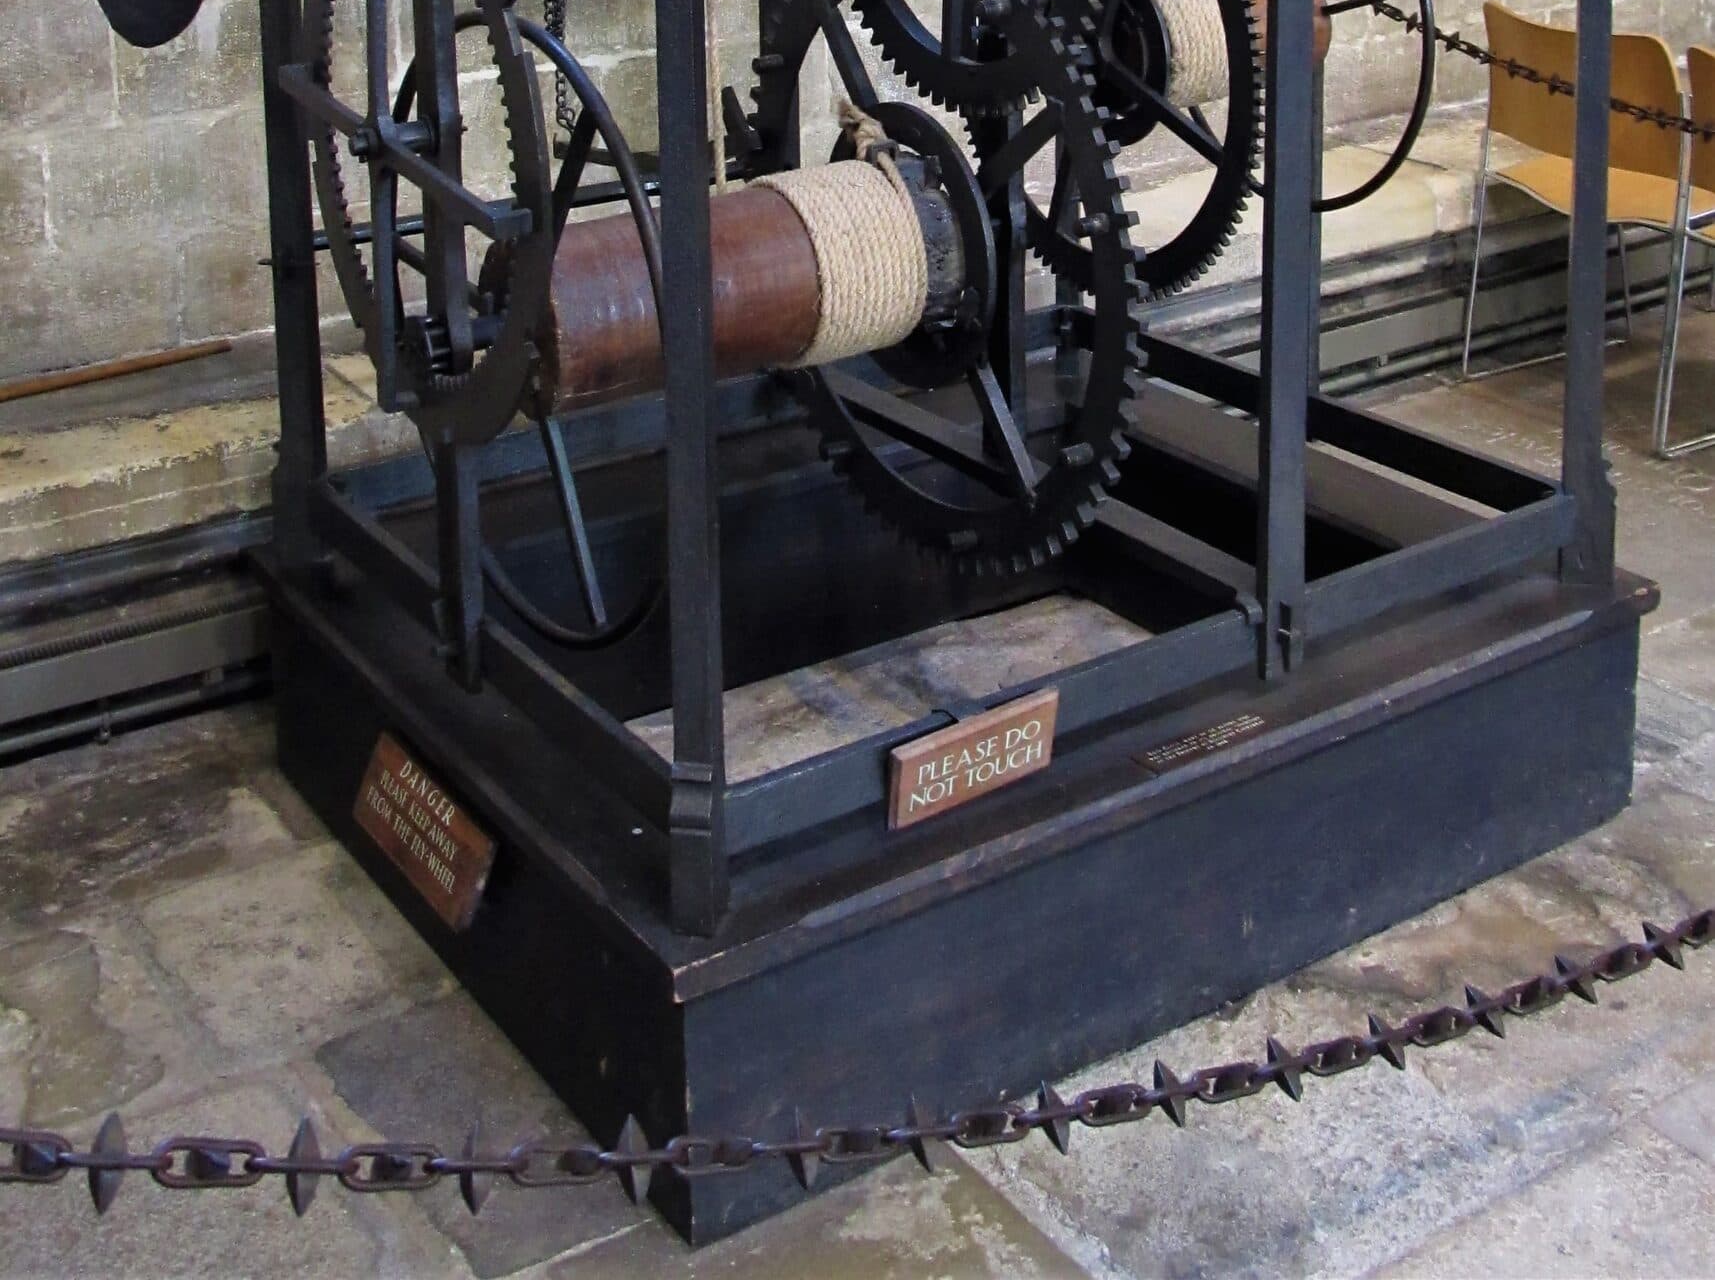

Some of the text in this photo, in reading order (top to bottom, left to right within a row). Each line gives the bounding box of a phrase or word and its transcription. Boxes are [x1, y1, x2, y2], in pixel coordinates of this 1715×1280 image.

[909, 743, 1042, 812] NOT TOUCH
[917, 720, 1041, 785] PLEASE DO
[366, 785, 392, 824] FROM
[391, 814, 409, 844] THE
[400, 760, 456, 826] DANGER
[408, 802, 433, 833] KEEP
[427, 823, 459, 863] AWAY
